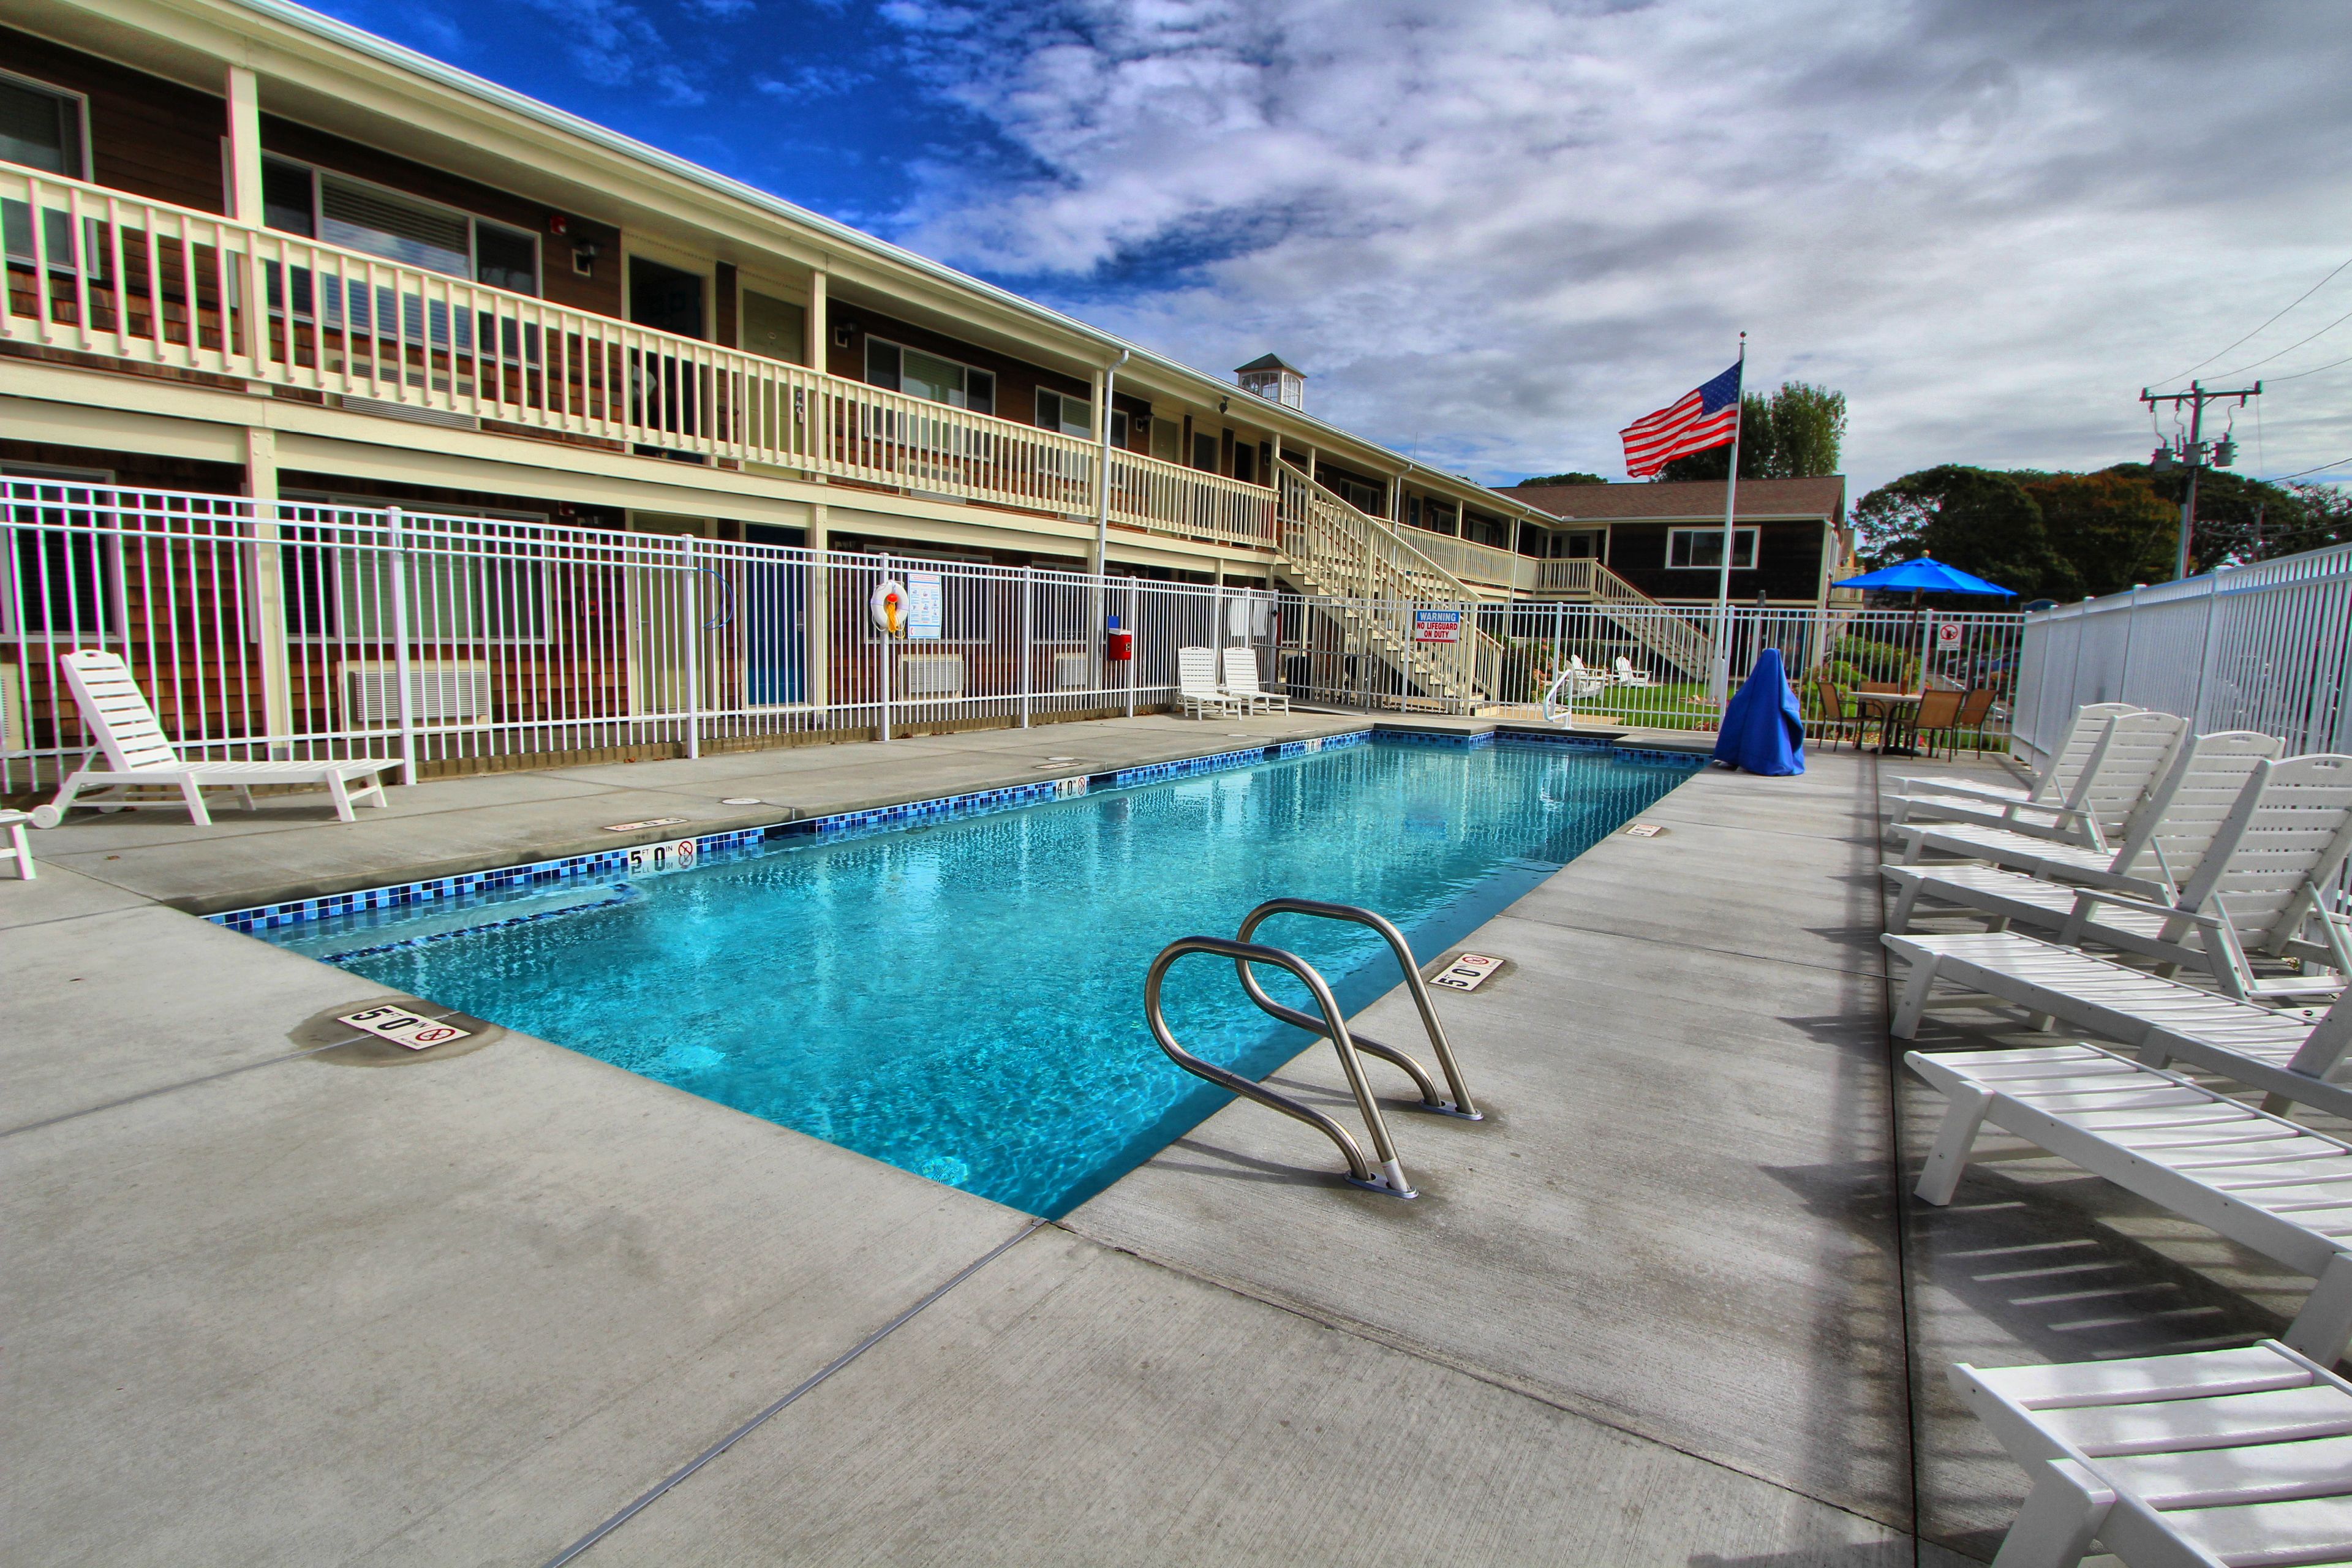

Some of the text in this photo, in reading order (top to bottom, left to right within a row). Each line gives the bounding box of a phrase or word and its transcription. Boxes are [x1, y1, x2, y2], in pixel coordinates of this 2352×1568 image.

[1420, 612, 1457, 622] WARNING
[630, 850, 642, 864] 5
[654, 846, 665, 861] 0
[1452, 968, 1481, 977] 0
[1438, 978, 1469, 987] 5
[351, 1008, 394, 1020] 5
[377, 1017, 419, 1030] 0
